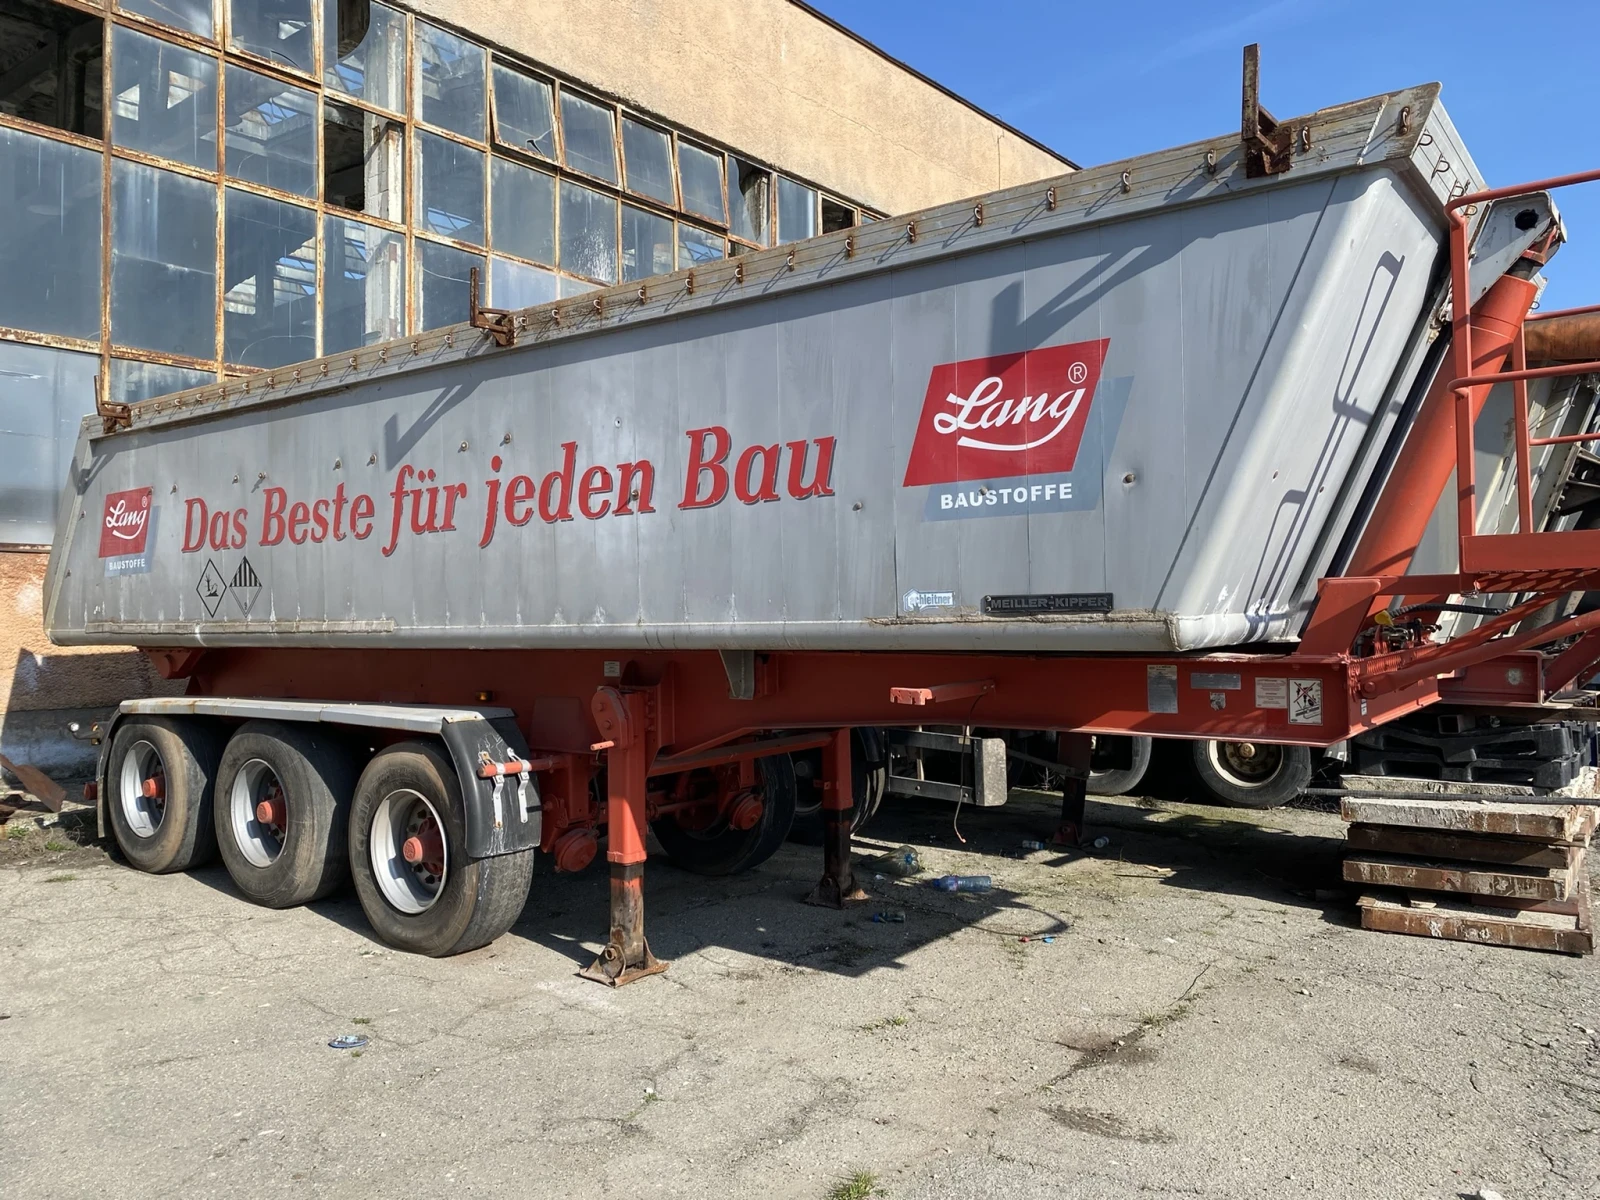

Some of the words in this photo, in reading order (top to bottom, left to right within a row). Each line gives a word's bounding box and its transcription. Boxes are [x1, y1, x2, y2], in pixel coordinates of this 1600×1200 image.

[933, 376, 1086, 451] Lang
[181, 497, 249, 554] Das
[259, 481, 375, 548] Beste
[381, 464, 467, 557] für
[479, 441, 656, 549] jeden
[677, 426, 836, 511] Bau
[940, 483, 1073, 509] BAUSTOFFE
[106, 499, 147, 540] Lang
[109, 558, 146, 571] BAUSTOFFE
